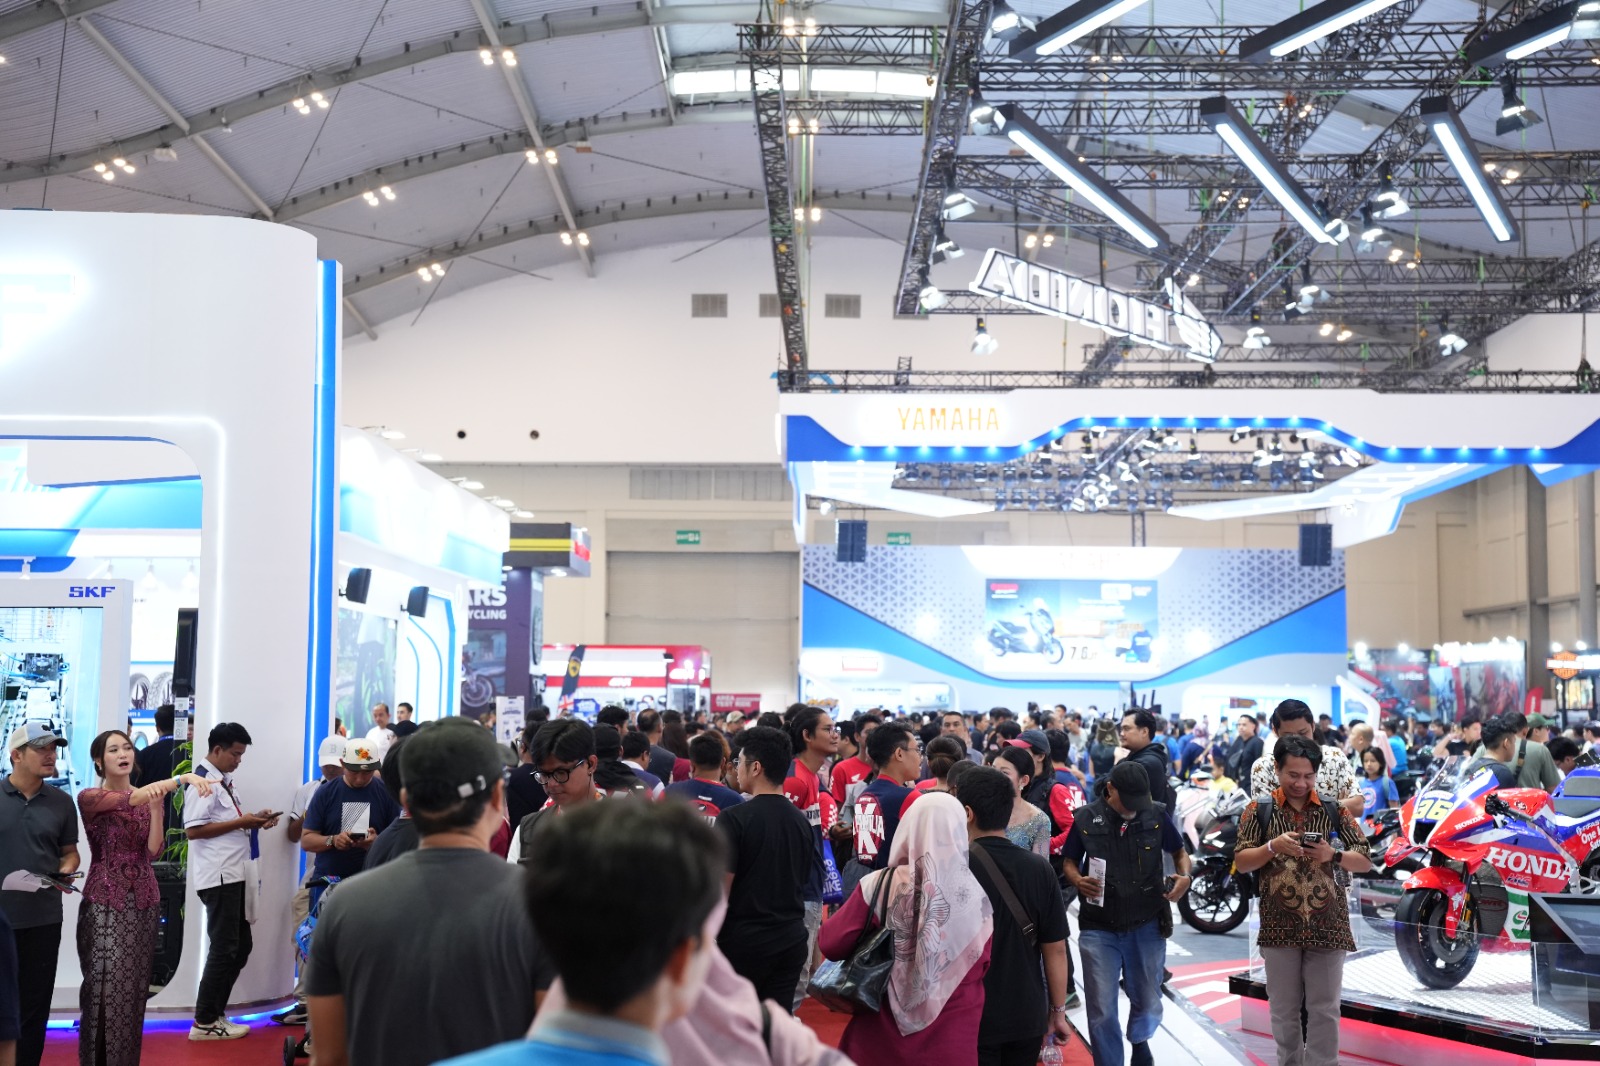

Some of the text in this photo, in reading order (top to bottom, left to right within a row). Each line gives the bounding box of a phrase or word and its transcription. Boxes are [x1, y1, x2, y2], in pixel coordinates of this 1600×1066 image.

[897, 407, 999, 431] YAMAHA
[69, 586, 116, 598] SKF
[1454, 814, 1485, 831] HONDA
[1581, 830, 1597, 845] One
[1485, 846, 1574, 881] HONDA
